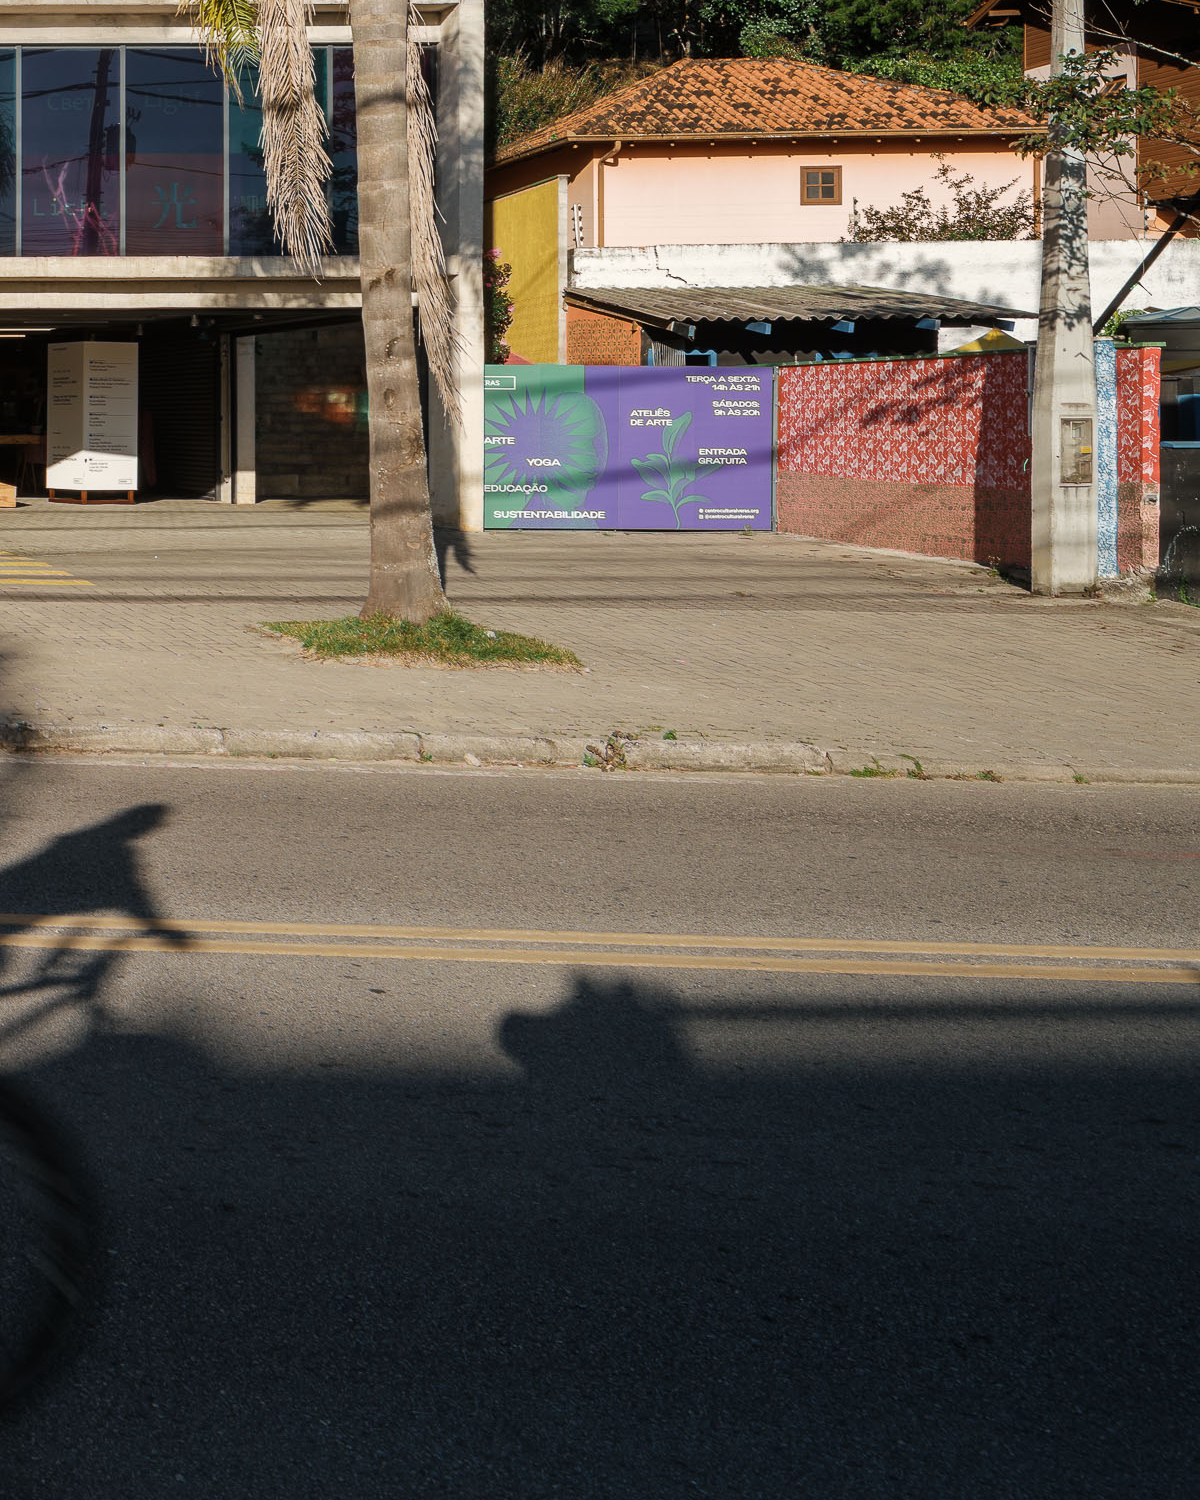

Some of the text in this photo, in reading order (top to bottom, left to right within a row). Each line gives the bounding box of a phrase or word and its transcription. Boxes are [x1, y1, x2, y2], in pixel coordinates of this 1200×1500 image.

[152, 183, 199, 229] 光
[686, 375, 716, 384] TERÇA
[730, 382, 743, 391] ÀS
[712, 398, 760, 408] SÁBADOS:
[630, 408, 671, 417] ATELIÊS
[727, 407, 741, 416] ÀS
[484, 437, 516, 445] ARTE
[526, 458, 561, 466] YOGA
[698, 457, 748, 465] GRATUITA
[484, 483, 548, 495] EDUCAÇÃO
[493, 510, 606, 519] SUSTENTABILIDADE
